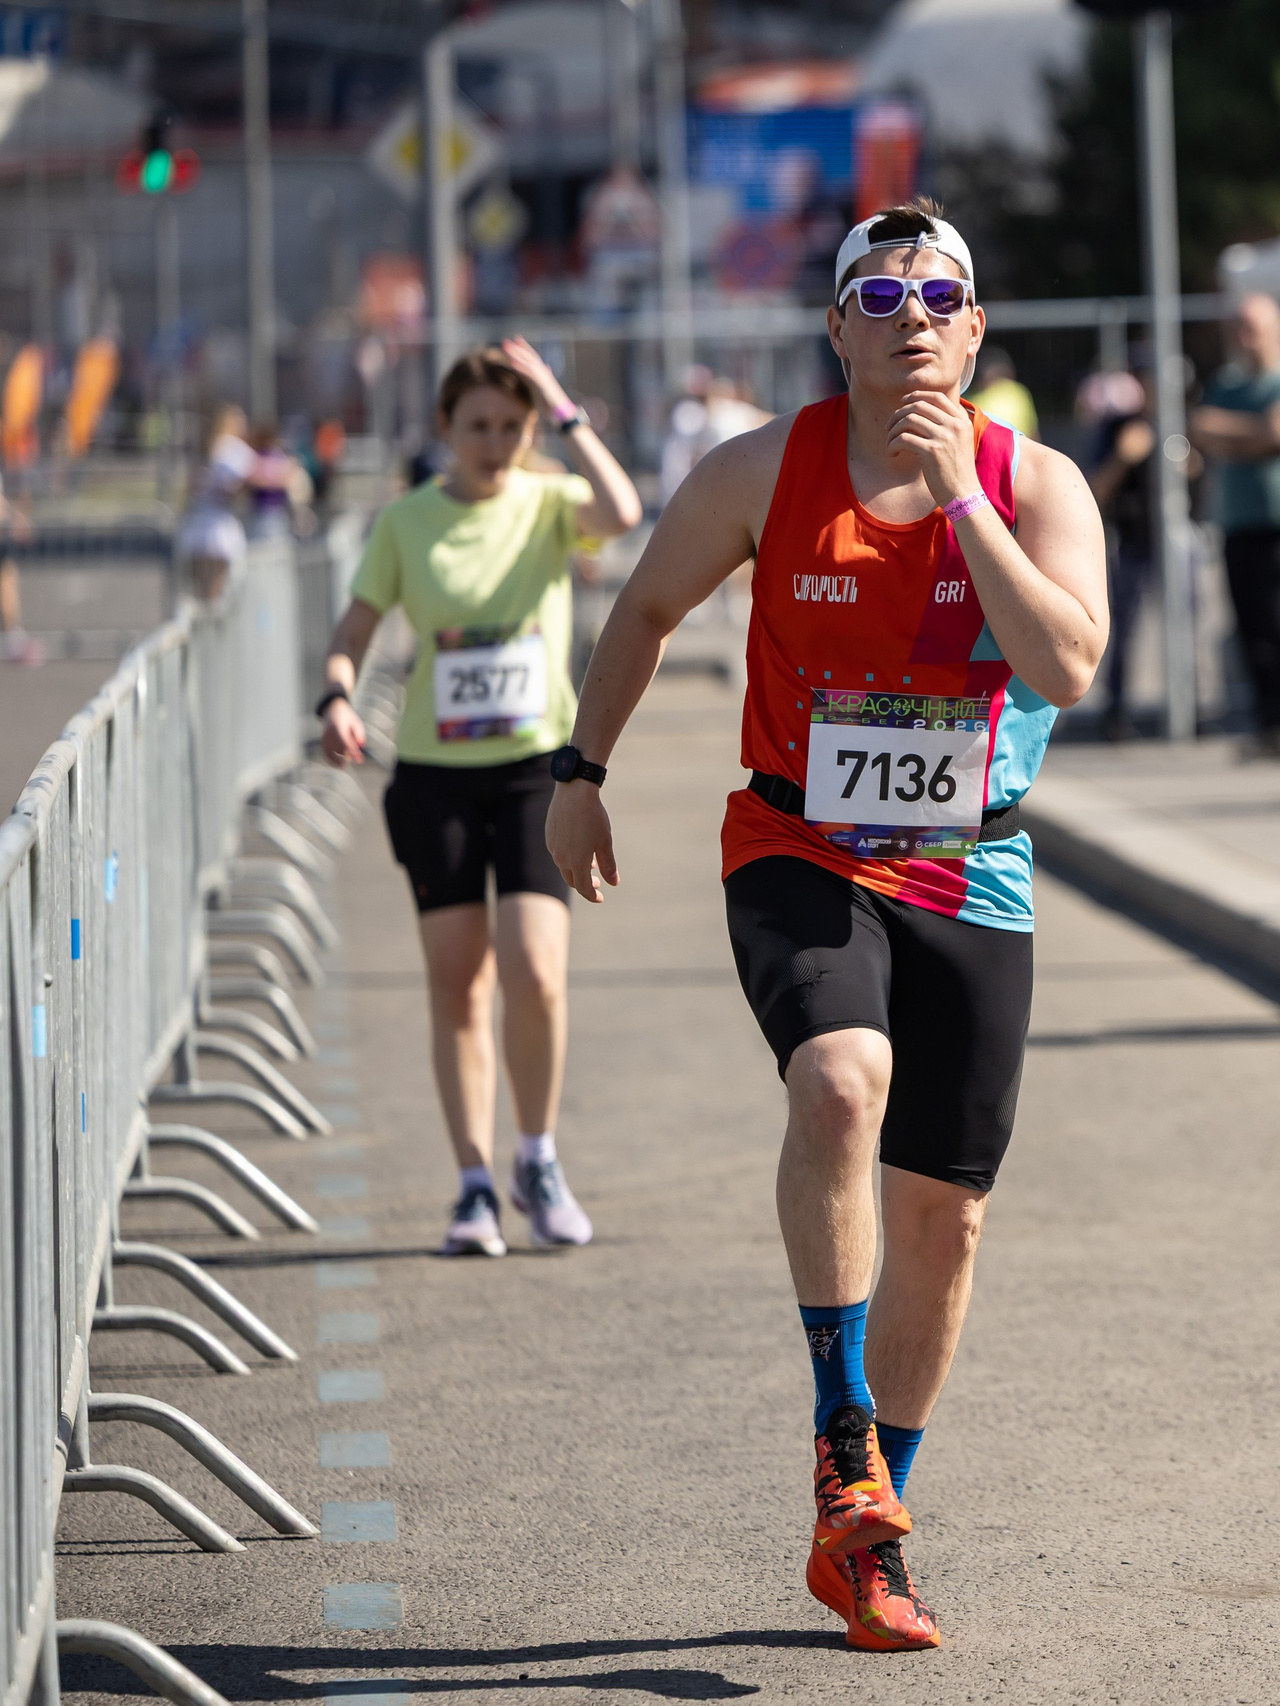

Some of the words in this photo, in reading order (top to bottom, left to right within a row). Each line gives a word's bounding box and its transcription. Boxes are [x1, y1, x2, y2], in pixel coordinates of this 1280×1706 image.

[449, 665, 530, 704] 2577
[828, 694, 976, 719] КРАСОЧНЫЙ
[827, 716, 904, 725] ЗАБЕГ
[913, 719, 986, 732] 2026
[836, 749, 956, 803] 7136
